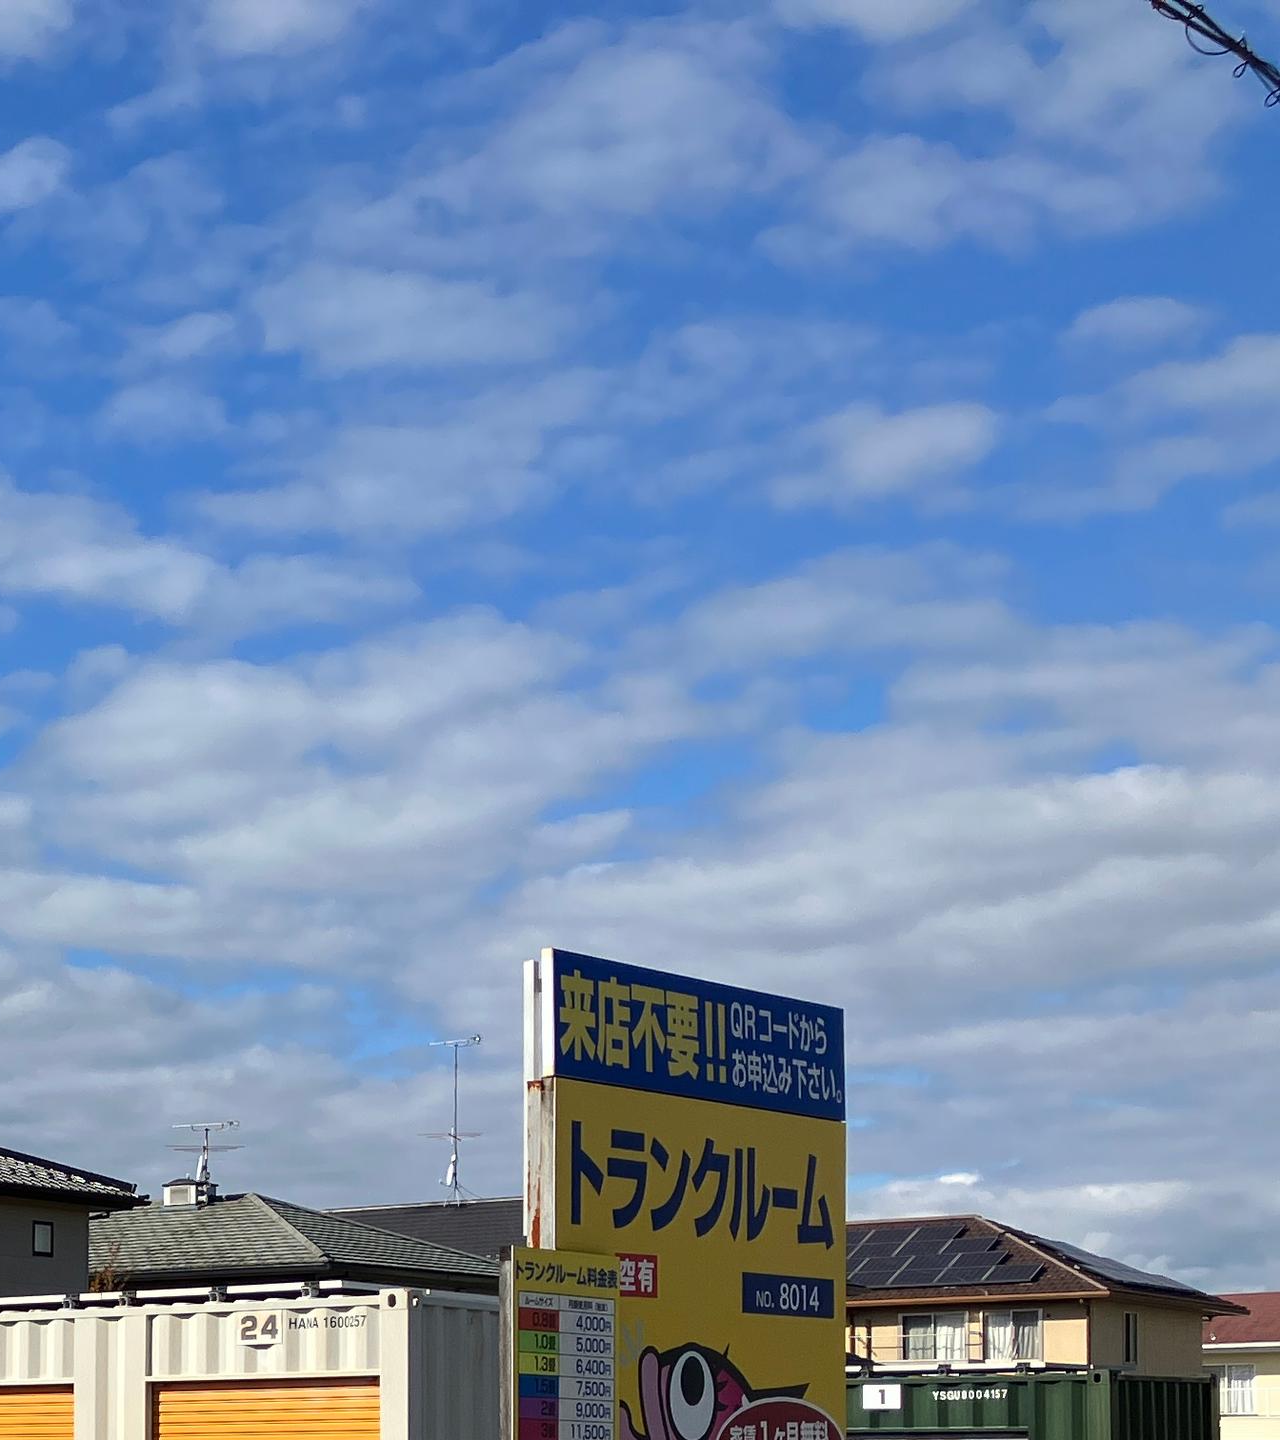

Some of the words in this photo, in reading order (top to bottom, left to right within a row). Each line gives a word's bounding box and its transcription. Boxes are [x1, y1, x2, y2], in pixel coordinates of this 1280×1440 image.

[559, 968, 727, 1084] 来店不要!!
[730, 1001, 828, 1055] QRコードから
[731, 1048, 843, 1104] お申込み下さい。
[570, 1119, 835, 1251] トランクルーム
[515, 1259, 619, 1289] トランクルーム料金表
[755, 1290, 775, 1309] NO.
[779, 1282, 820, 1312] 8014
[240, 1314, 280, 1342] 24
[287, 1316, 319, 1330] HANA
[877, 1388, 886, 1405] 1
